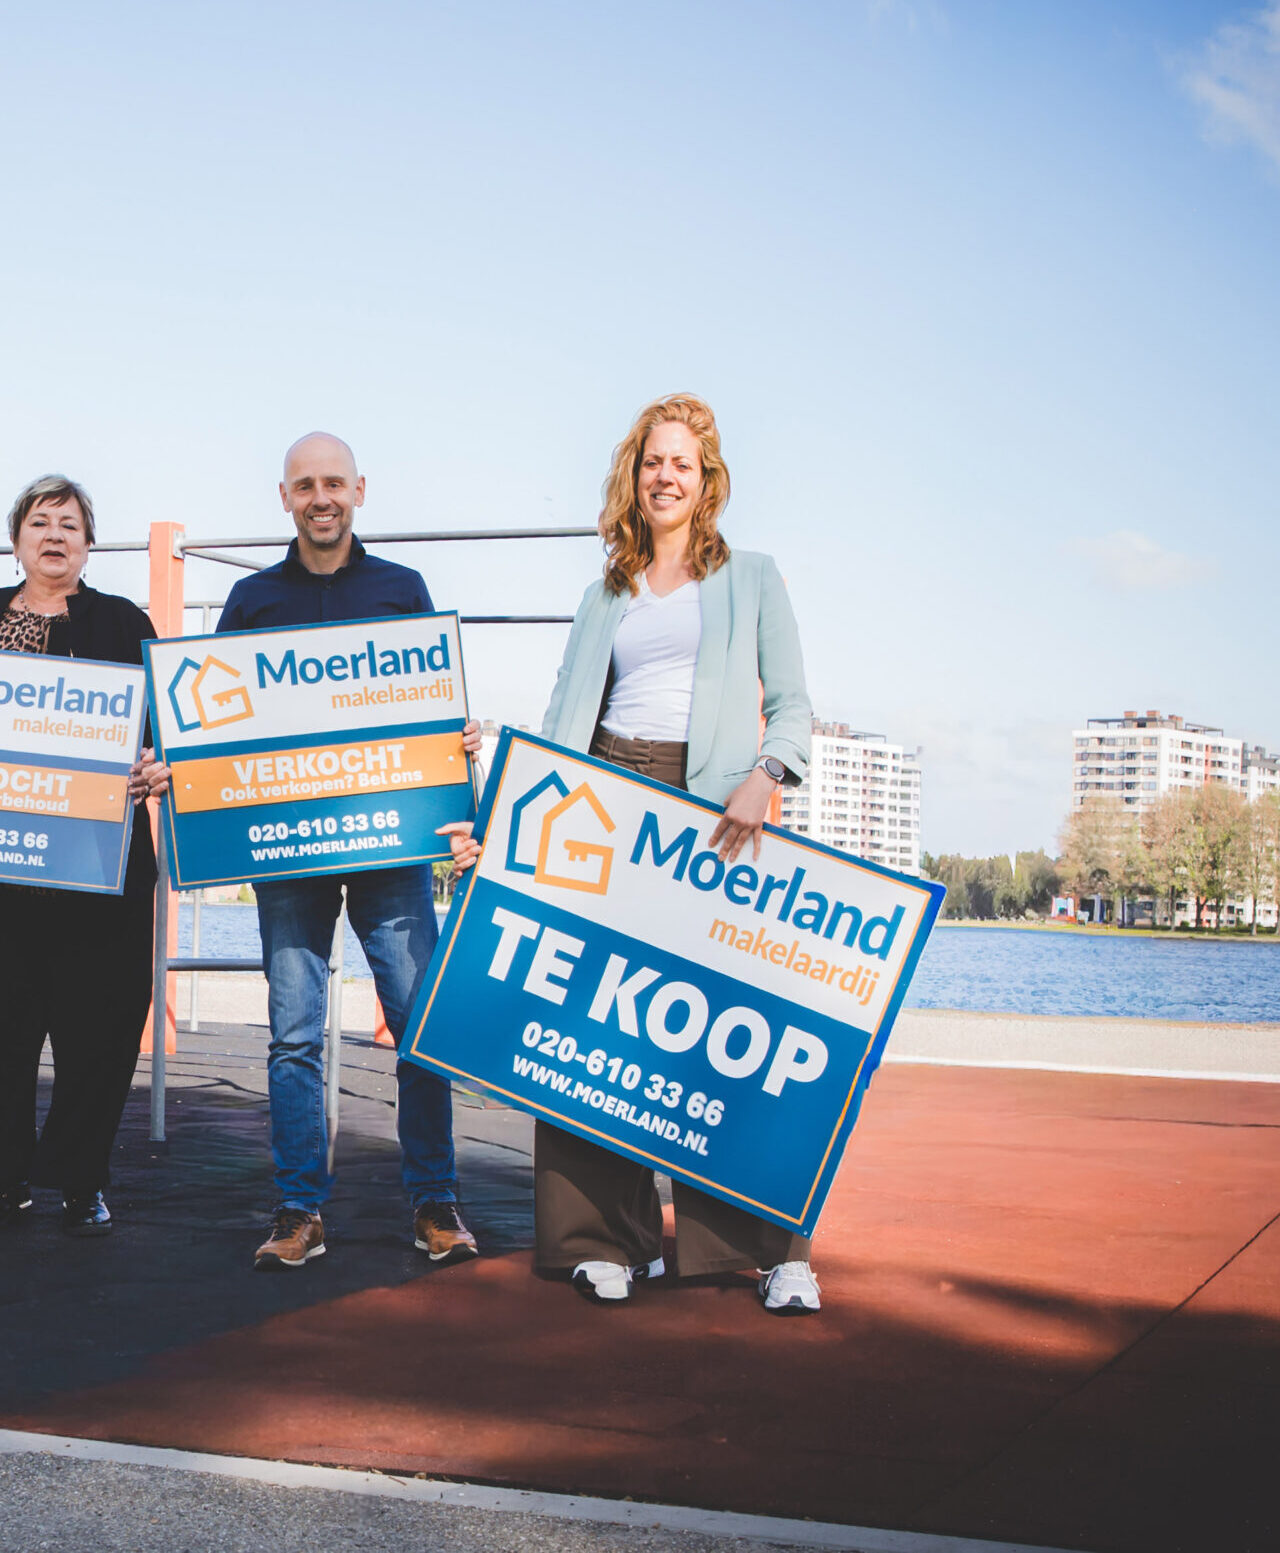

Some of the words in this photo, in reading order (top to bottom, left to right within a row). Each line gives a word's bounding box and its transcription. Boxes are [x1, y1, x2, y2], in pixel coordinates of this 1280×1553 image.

[255, 633, 451, 689] Moerland
[331, 678, 454, 709] makelaardij
[12, 717, 129, 747] makelaardij
[233, 744, 405, 785] VERKOCHT
[220, 785, 258, 802] Ook
[262, 775, 354, 799] verkopen?
[358, 771, 387, 787] Bel
[390, 769, 423, 784] ons
[23, 832, 49, 849] 66
[249, 817, 337, 843] 020-610
[342, 813, 369, 832] 33
[373, 810, 400, 828] 66
[251, 833, 402, 861] WWW.MOERLAND.NL
[629, 811, 905, 961] Moerland
[708, 918, 881, 1006] makelaardij
[487, 906, 586, 1005] TE
[587, 956, 829, 1098] KOOP
[522, 1021, 641, 1091] 020-610
[644, 1074, 681, 1109] 33
[687, 1091, 725, 1126] 66
[512, 1055, 709, 1156] WWW.MOERLAND.NL
